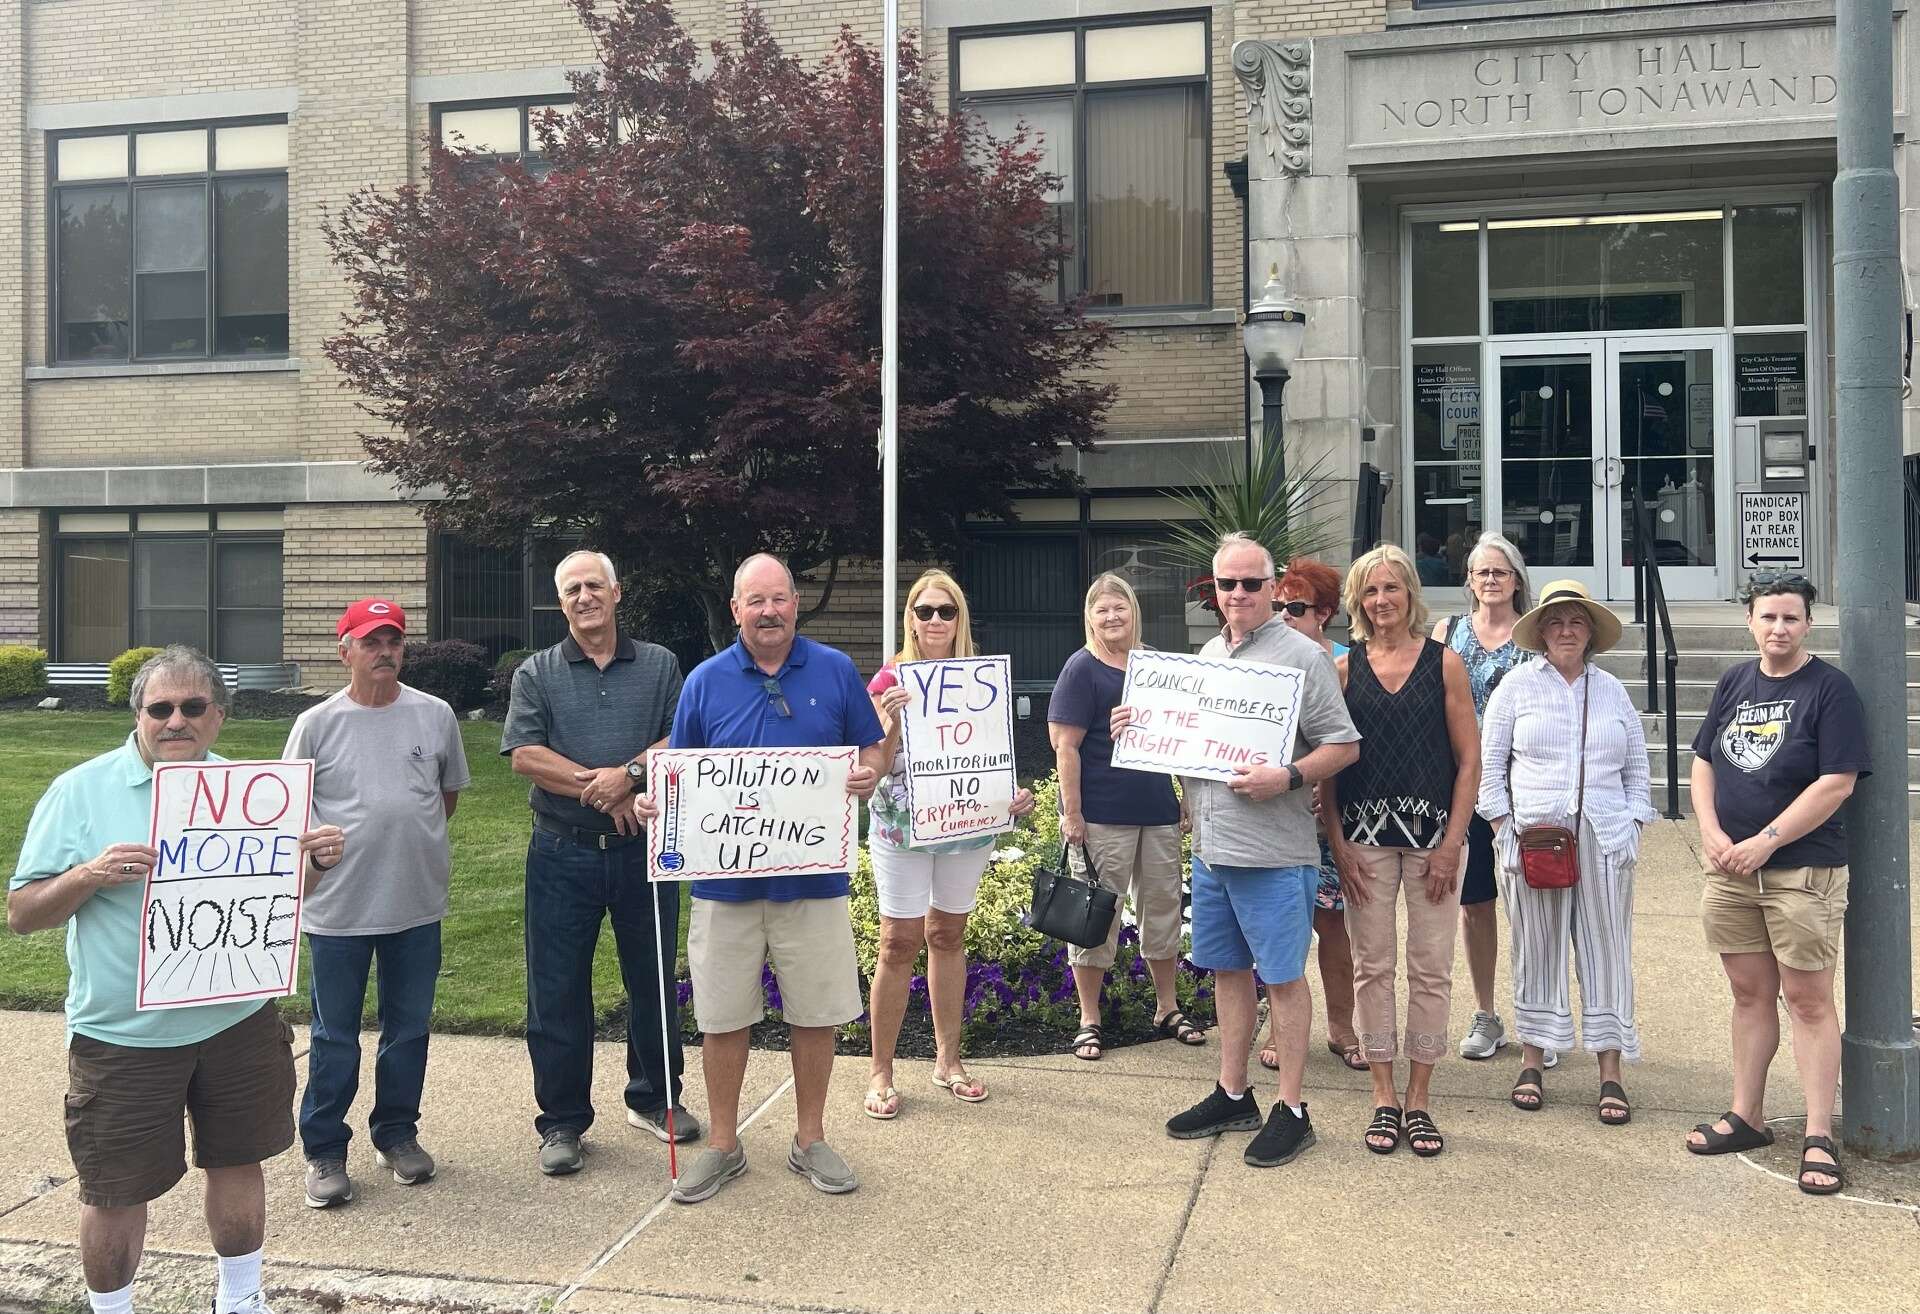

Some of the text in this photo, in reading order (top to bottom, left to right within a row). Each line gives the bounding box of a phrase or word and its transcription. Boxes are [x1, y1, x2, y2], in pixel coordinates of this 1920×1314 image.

[1475, 41, 1762, 86] CITY HALL
[1380, 74, 1838, 130] NORTH TONAWAND
[1447, 408, 1479, 419] COUR
[1460, 428, 1480, 439] PROCE
[1464, 451, 1480, 460] SECU
[1745, 497, 1799, 508] HANDICAP
[1745, 510, 1800, 522] DROP BOX
[1750, 524, 1795, 535] AT REAR
[1746, 538, 1800, 548] ENTRANCE
[913, 664, 998, 717] YES
[1134, 668, 1206, 694] COUNCIL
[1128, 706, 1200, 728] DO THE
[1739, 708, 1767, 723] CLEAN
[936, 721, 973, 751] TO
[1123, 729, 1268, 766] RIGHT THING
[188, 770, 290, 826] NO
[950, 777, 980, 798] NO
[739, 792, 760, 808] IS
[700, 813, 826, 846] CATCHING
[941, 816, 997, 833] CURRENCY
[158, 833, 298, 876] MORE
[718, 842, 768, 869] UP
[148, 893, 300, 953] NOISE
